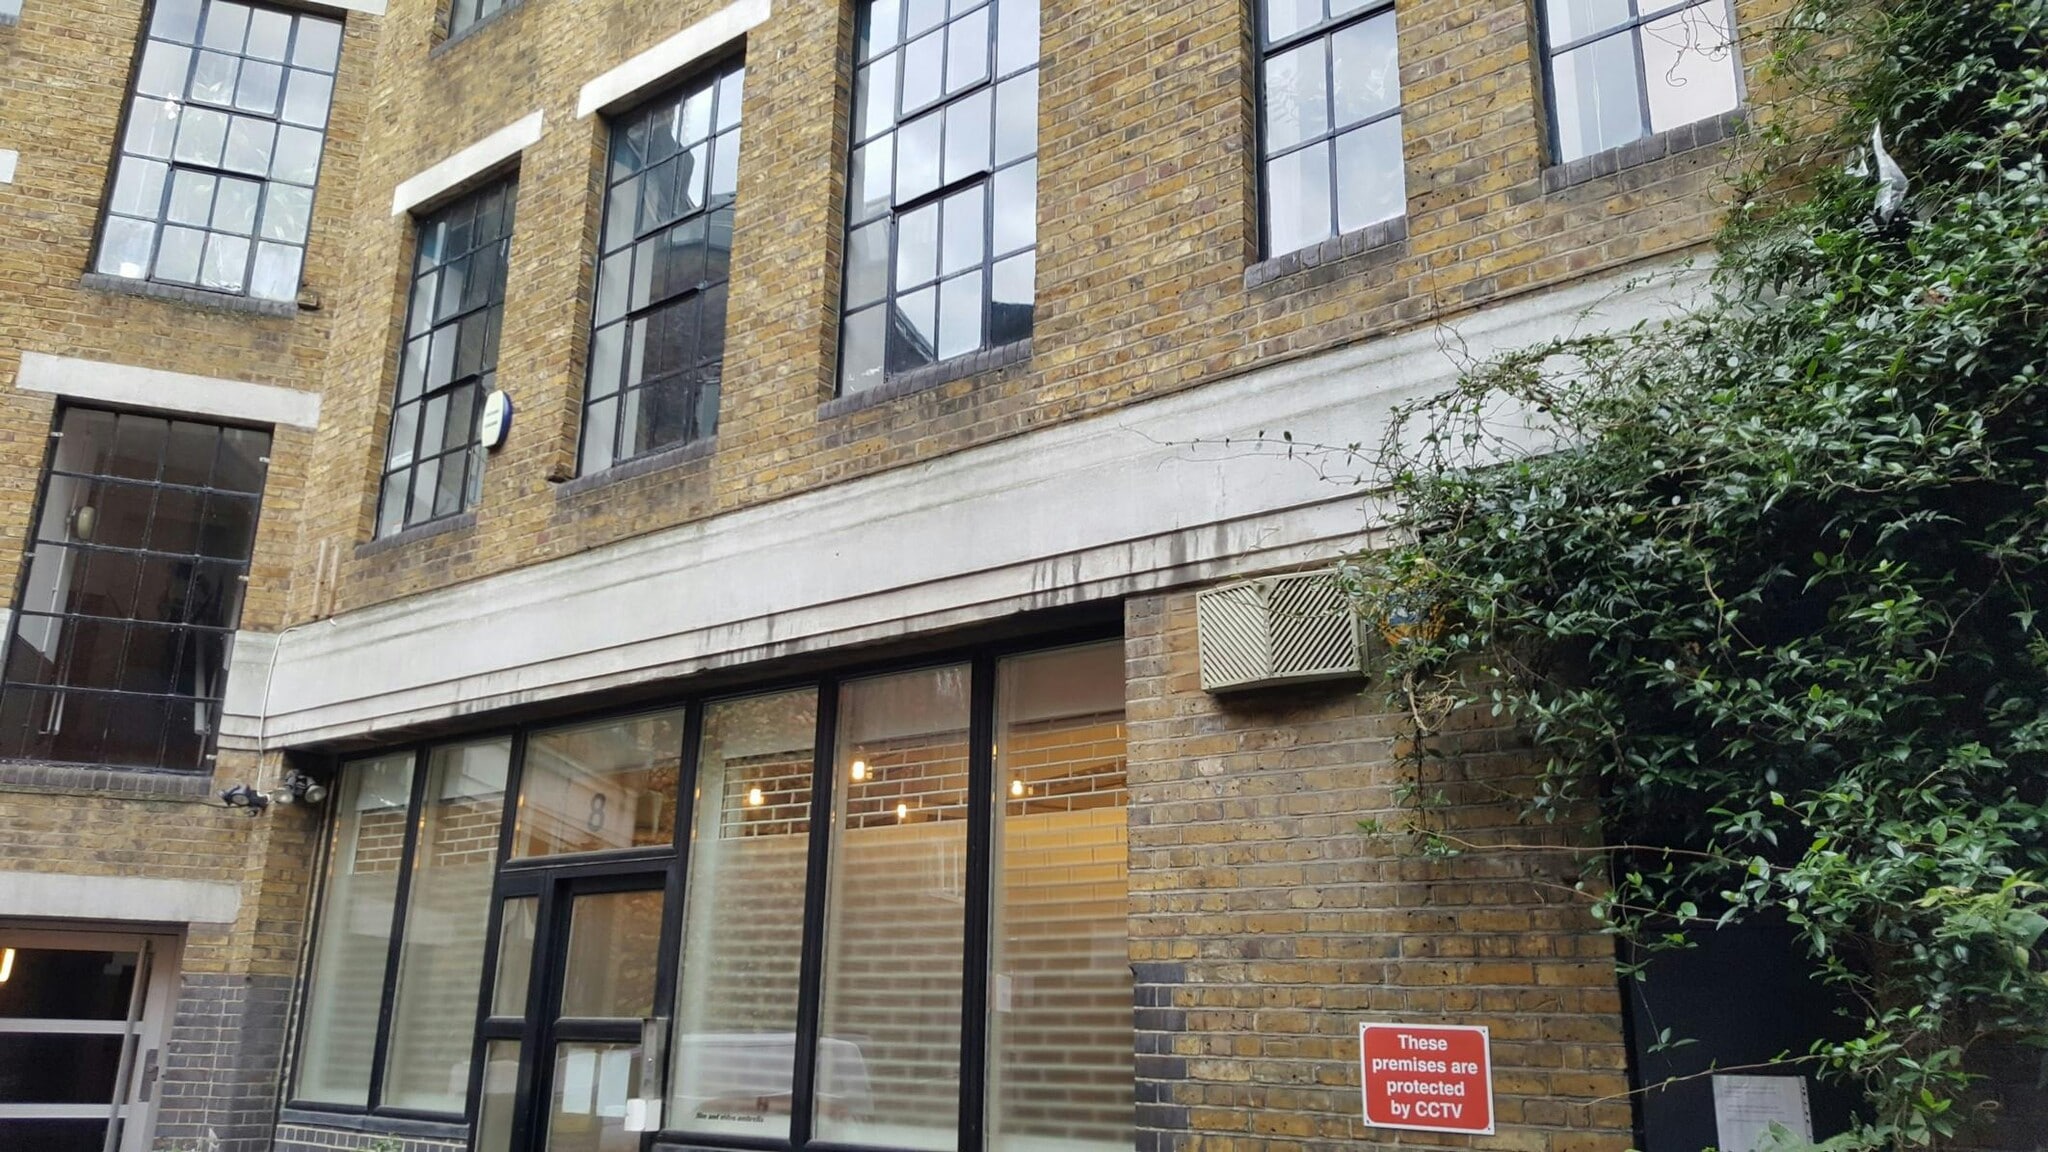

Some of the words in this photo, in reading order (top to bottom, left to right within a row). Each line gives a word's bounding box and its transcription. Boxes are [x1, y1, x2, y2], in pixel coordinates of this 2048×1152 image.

[587, 792, 606, 833] 8
[1397, 1034, 1448, 1051] These
[1372, 1057, 1447, 1073] premises
[1451, 1061, 1478, 1074] are
[1386, 1080, 1465, 1097] protected
[1390, 1100, 1410, 1119] by
[1415, 1101, 1463, 1118] CCTV
